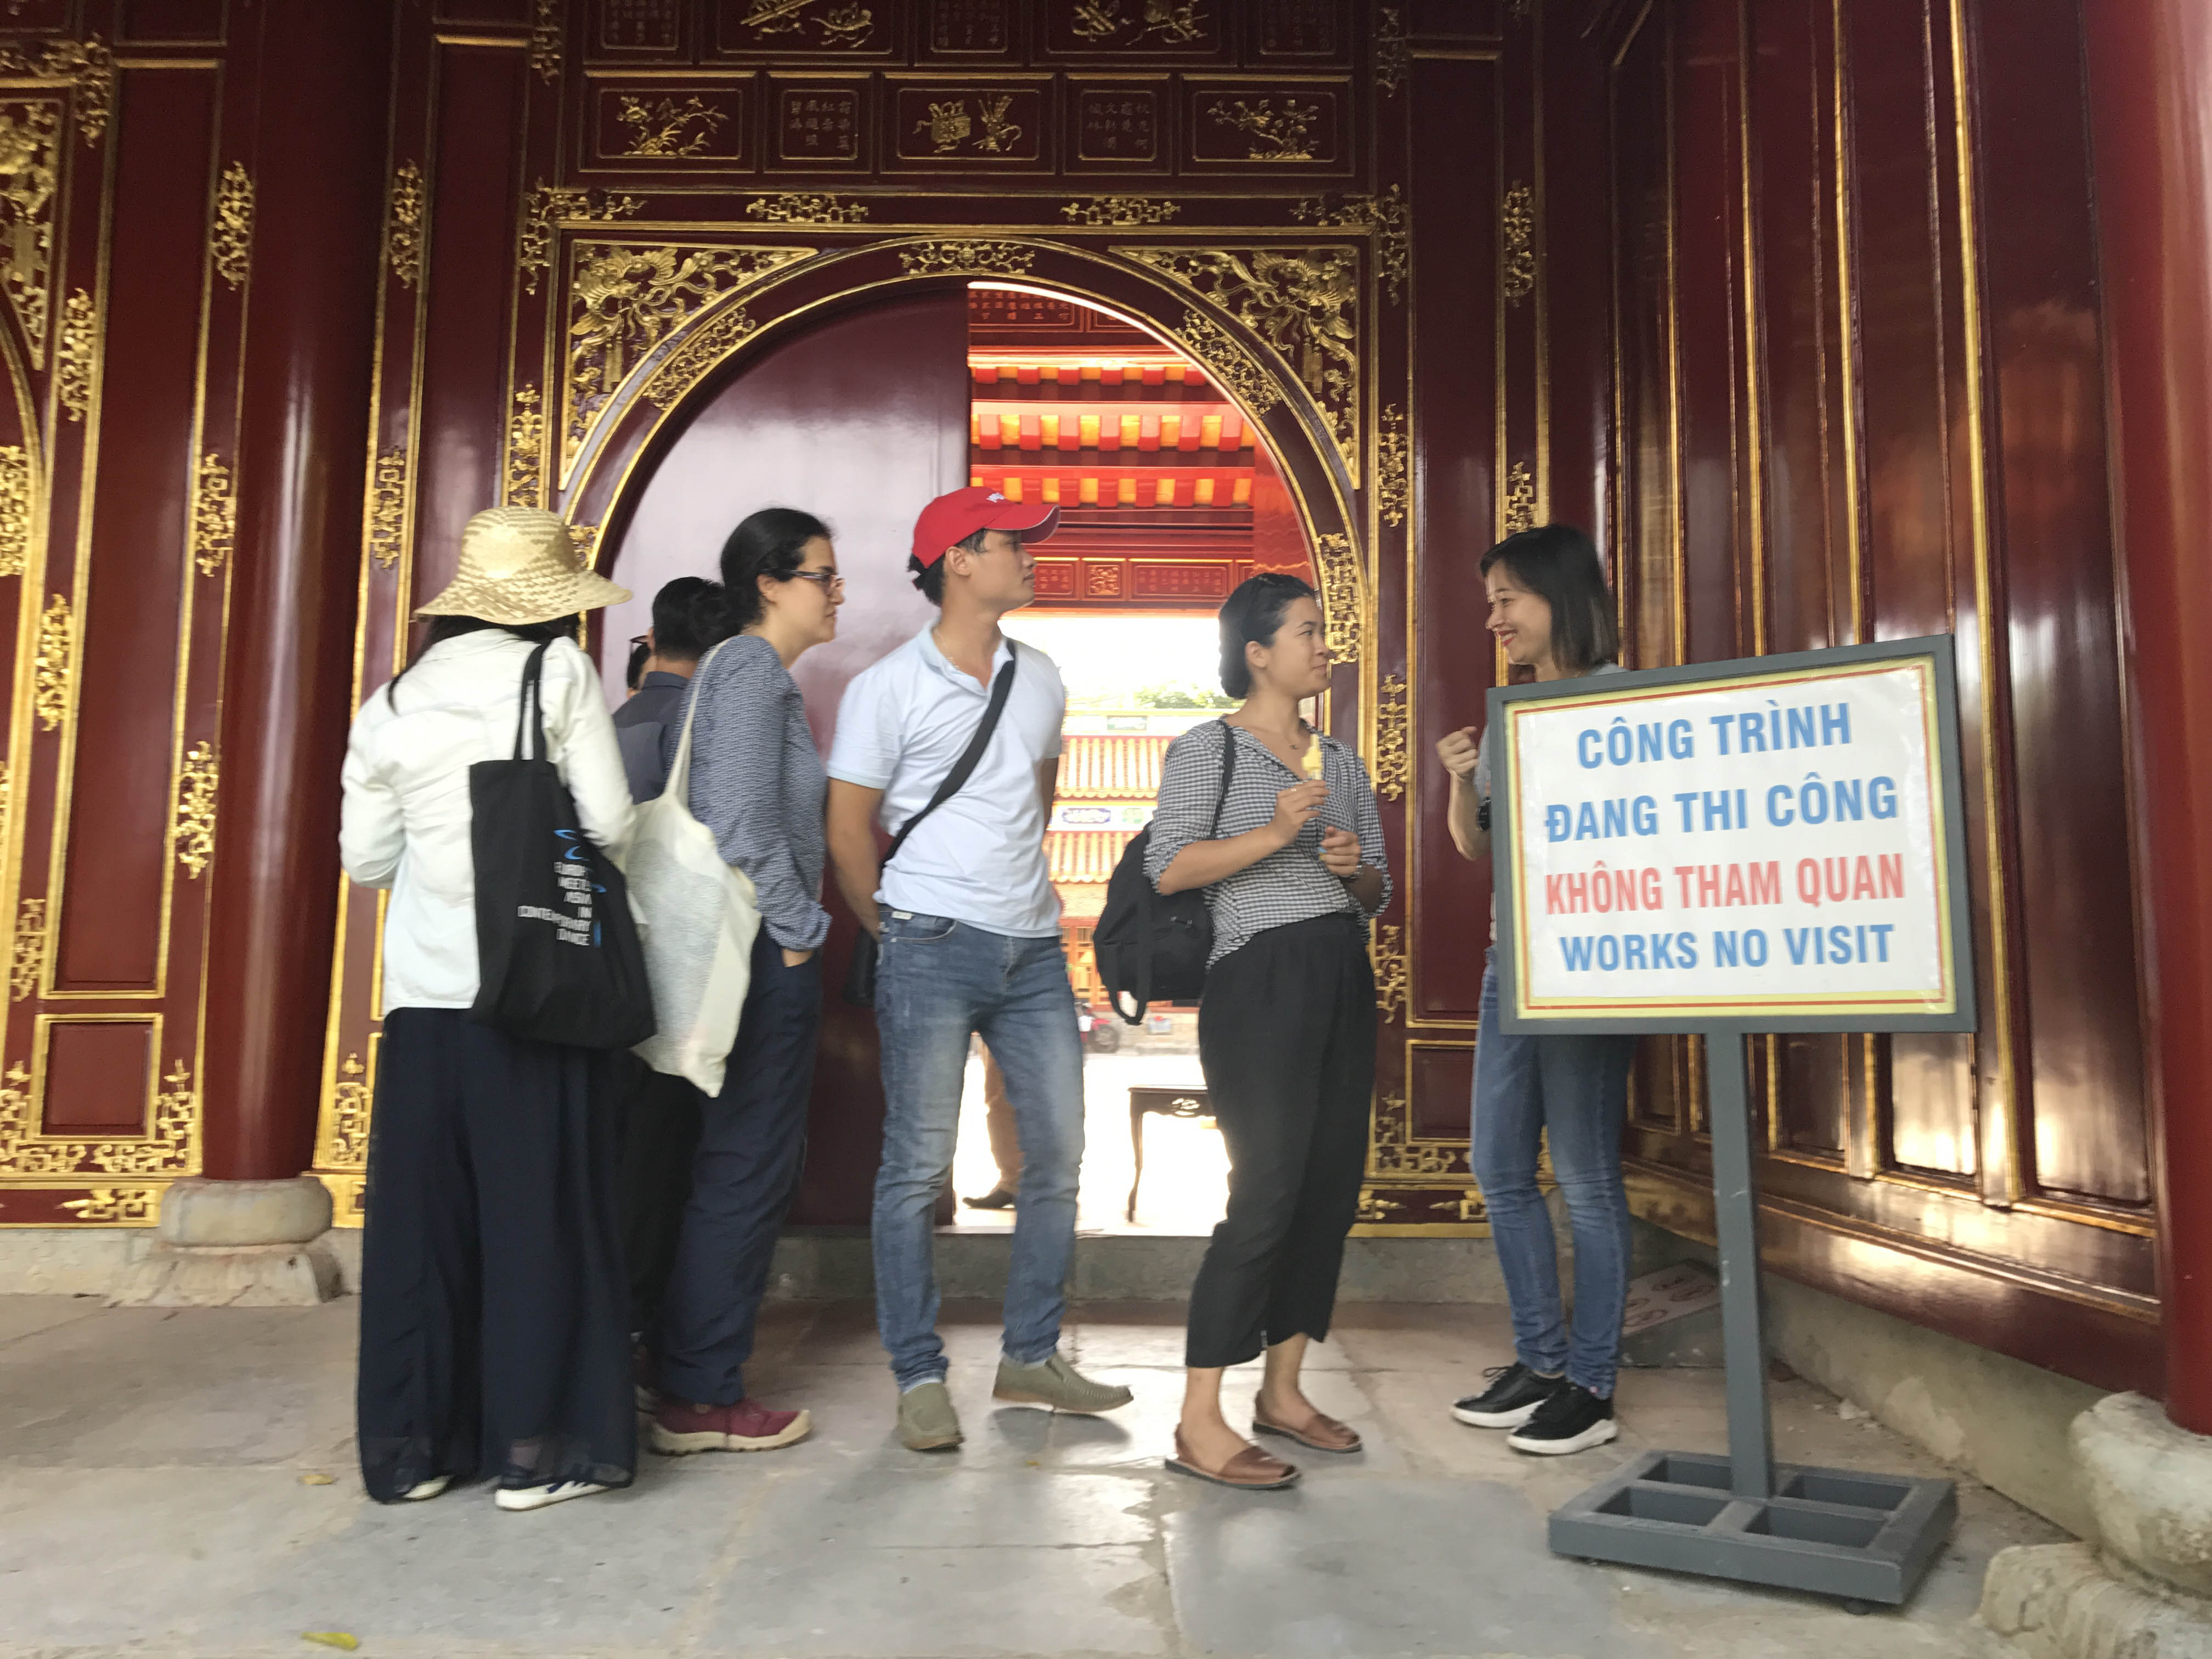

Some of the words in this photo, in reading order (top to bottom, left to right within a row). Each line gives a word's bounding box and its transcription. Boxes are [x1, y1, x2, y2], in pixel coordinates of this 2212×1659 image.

[1578, 717, 1694, 768] CÔNG
[1710, 700, 1850, 755] TRÌNH
[1545, 795, 1657, 842] ĐANG
[1674, 789, 1747, 832] THI
[1767, 772, 1897, 826] CÔNG
[1545, 860, 1663, 915] KHÔNG
[1674, 861, 1782, 909] THAM
[1797, 853, 1905, 907] QUAN
[1560, 932, 1698, 972] WORKS
[1714, 929, 1768, 967] NO
[1784, 924, 1893, 964] VISIT
